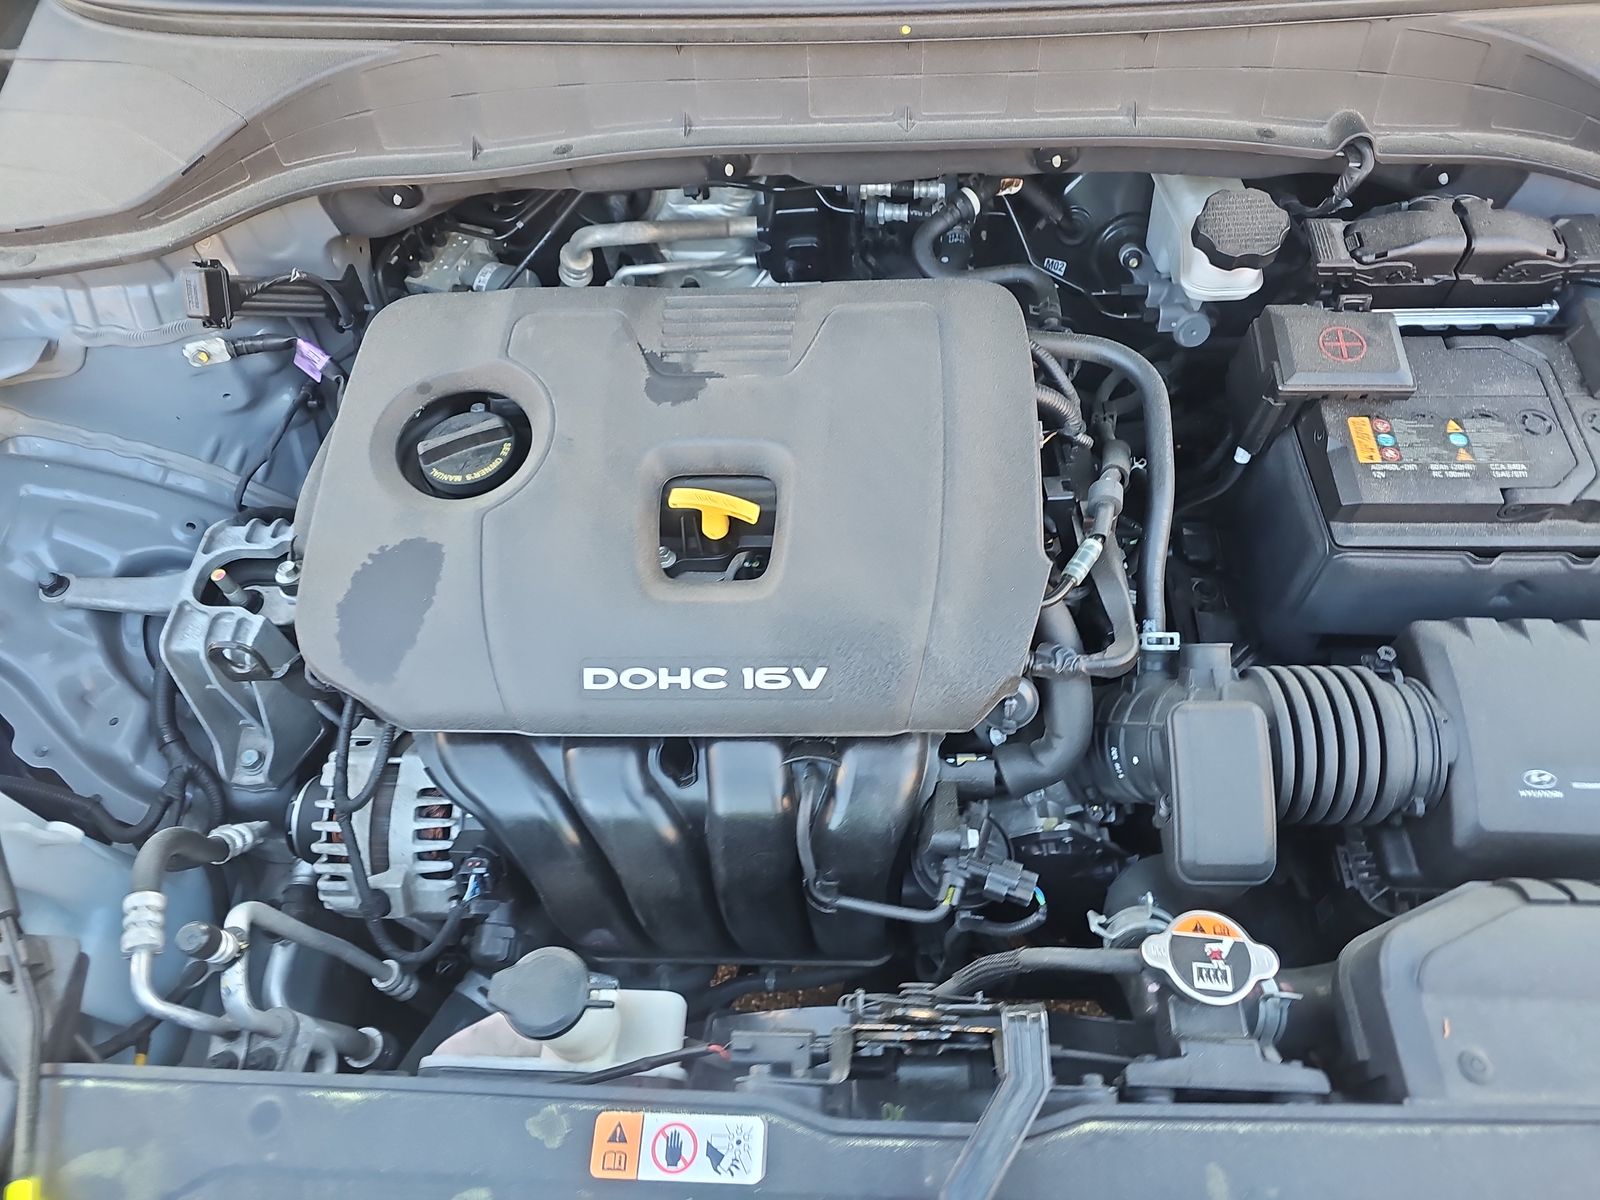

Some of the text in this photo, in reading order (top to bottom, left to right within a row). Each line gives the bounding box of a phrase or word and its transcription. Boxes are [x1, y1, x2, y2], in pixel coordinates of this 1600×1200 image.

[1045, 259, 1065, 273] M02
[500, 442, 512, 457] SEE
[430, 467, 463, 482] MANUAL
[1372, 471, 1386, 479] 12V
[583, 666, 829, 690] DOHC 16V
